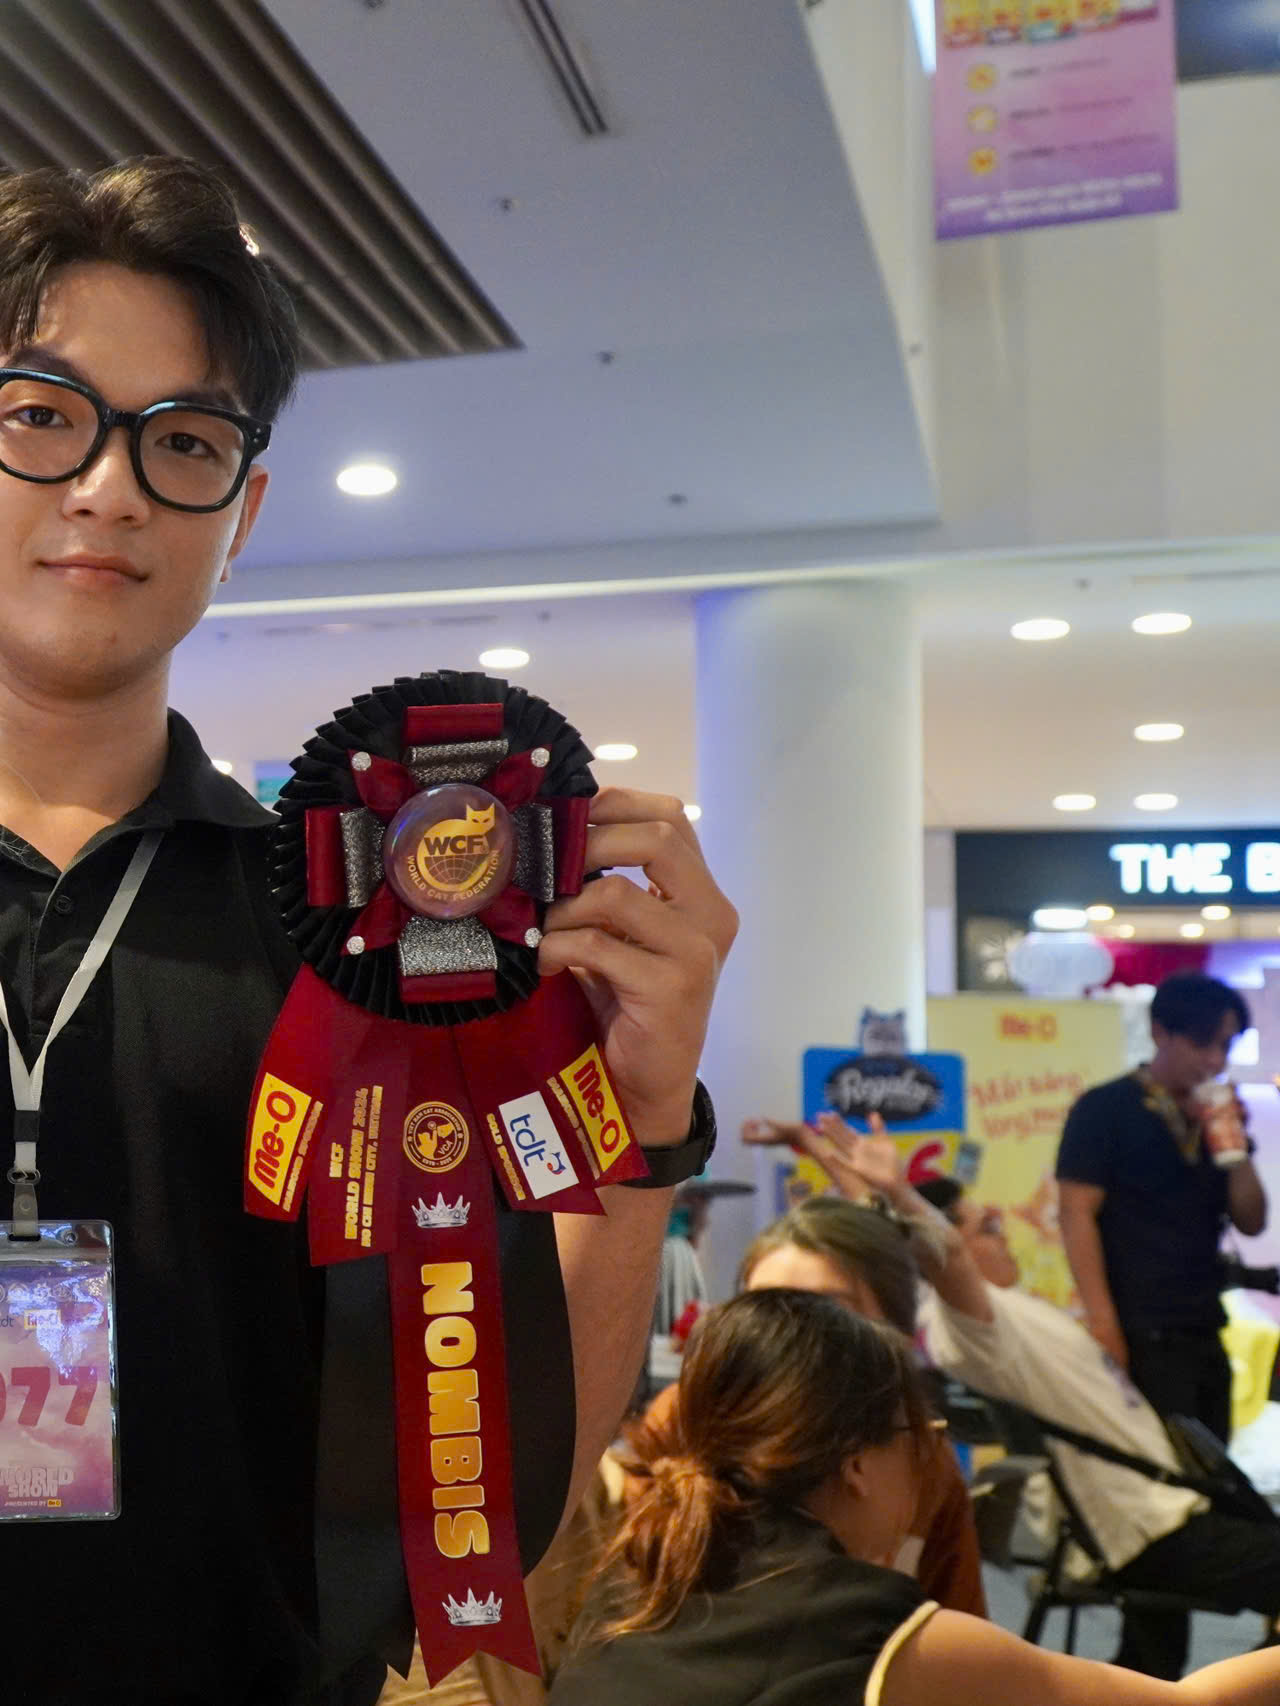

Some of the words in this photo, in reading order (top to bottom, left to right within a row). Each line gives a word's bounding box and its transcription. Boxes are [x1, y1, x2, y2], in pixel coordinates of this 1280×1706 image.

[424, 834, 484, 855] WCF
[1109, 843, 1233, 894] THE
[406, 854, 427, 891] WORLD
[427, 888, 449, 901] CAT
[452, 849, 502, 901] FEDERATION
[573, 1059, 621, 1153] Me-O
[254, 1090, 296, 1189] Me-O
[348, 1128, 365, 1179] SHOW
[437, 1139, 454, 1155] VCA
[510, 1113, 546, 1167] tdt
[345, 1181, 360, 1239] WORLD
[420, 1260, 490, 1558] NOMBIS
[8, 1481, 58, 1498] SHOW
